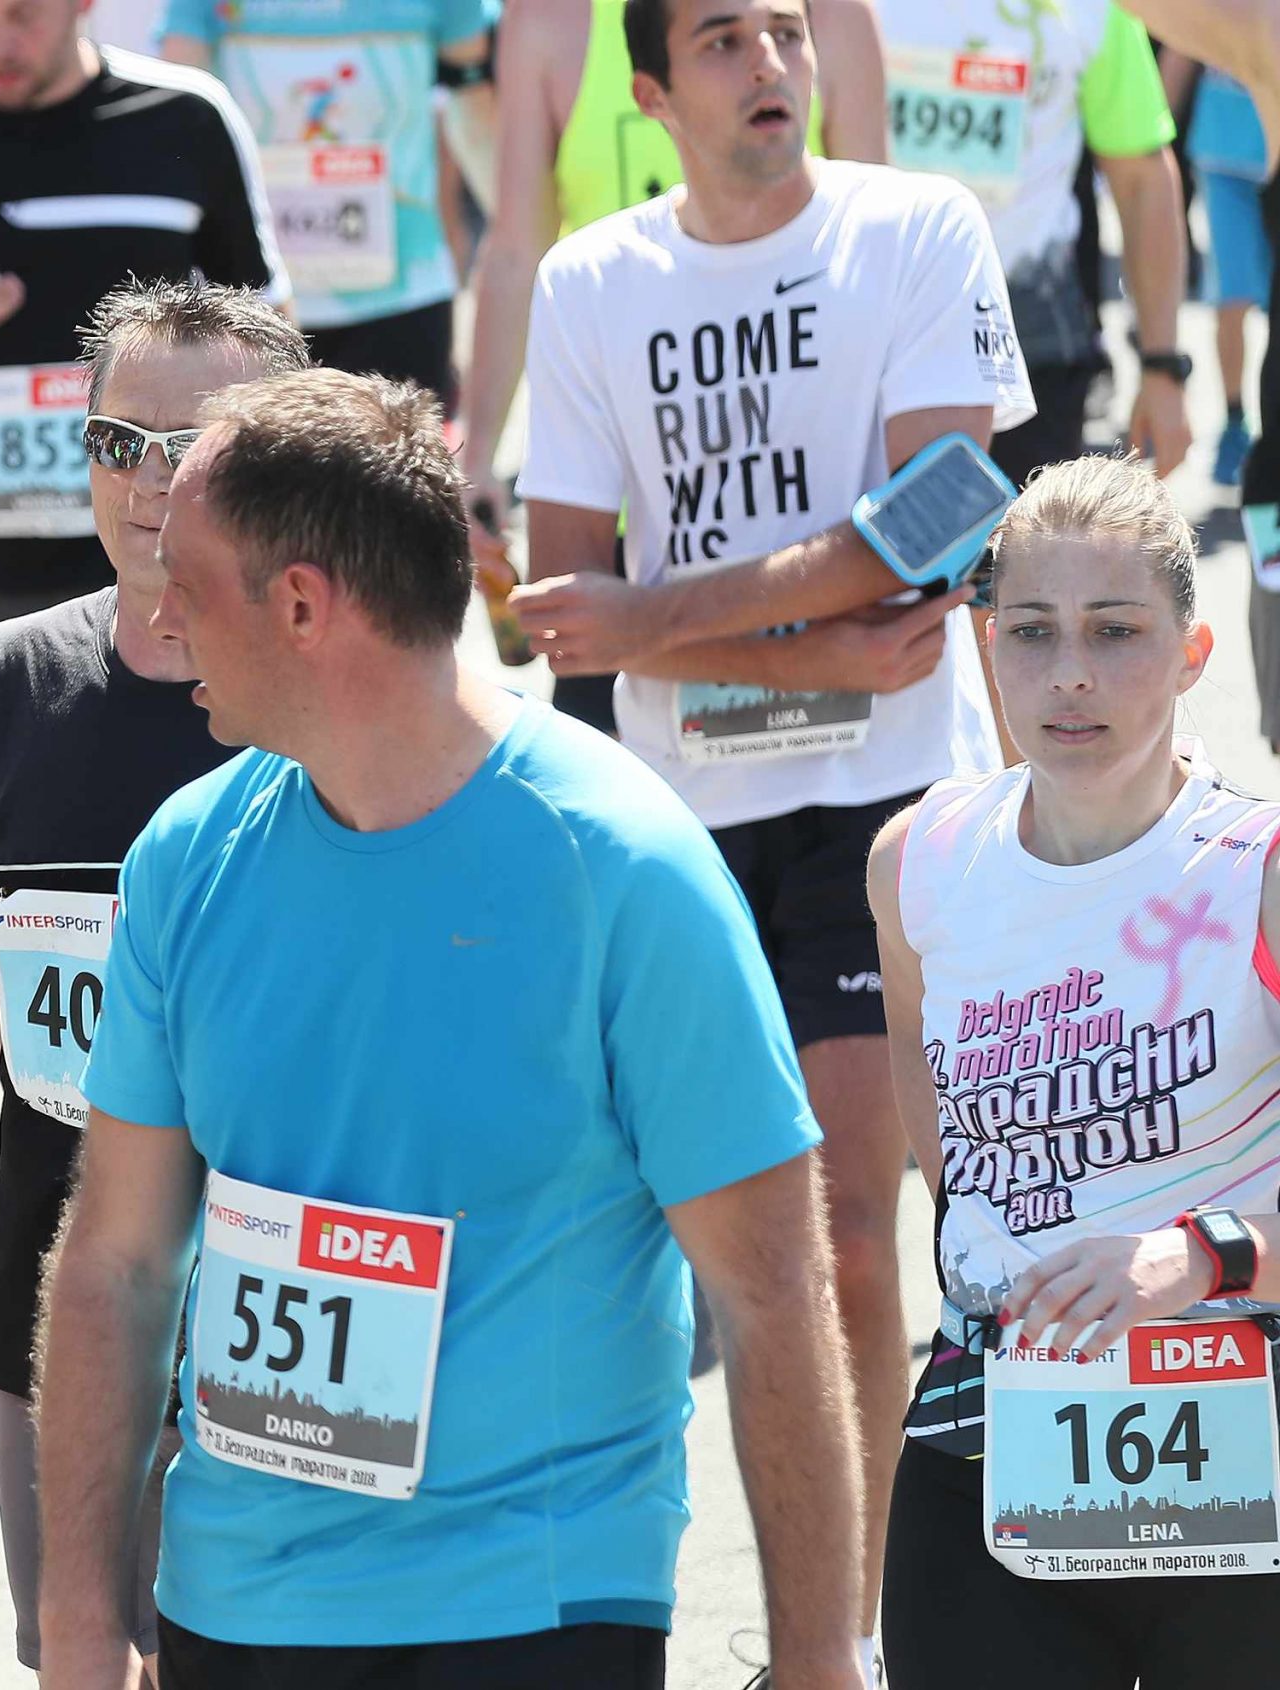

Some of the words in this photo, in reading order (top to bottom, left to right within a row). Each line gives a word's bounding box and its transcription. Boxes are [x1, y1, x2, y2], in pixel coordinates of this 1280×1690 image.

[648, 303, 819, 395] COME
[654, 382, 771, 465] RUN
[664, 447, 810, 524] WITH
[767, 708, 809, 730] LUKA
[7, 914, 104, 935] INTERSPORT
[956, 966, 1105, 1045] Belgrade
[951, 1007, 1123, 1088] marathon
[228, 1273, 353, 1385] 551
[265, 1413, 334, 1447] DARKO
[1054, 1401, 1209, 1485] 164
[1127, 1522, 1184, 1543] LENA
